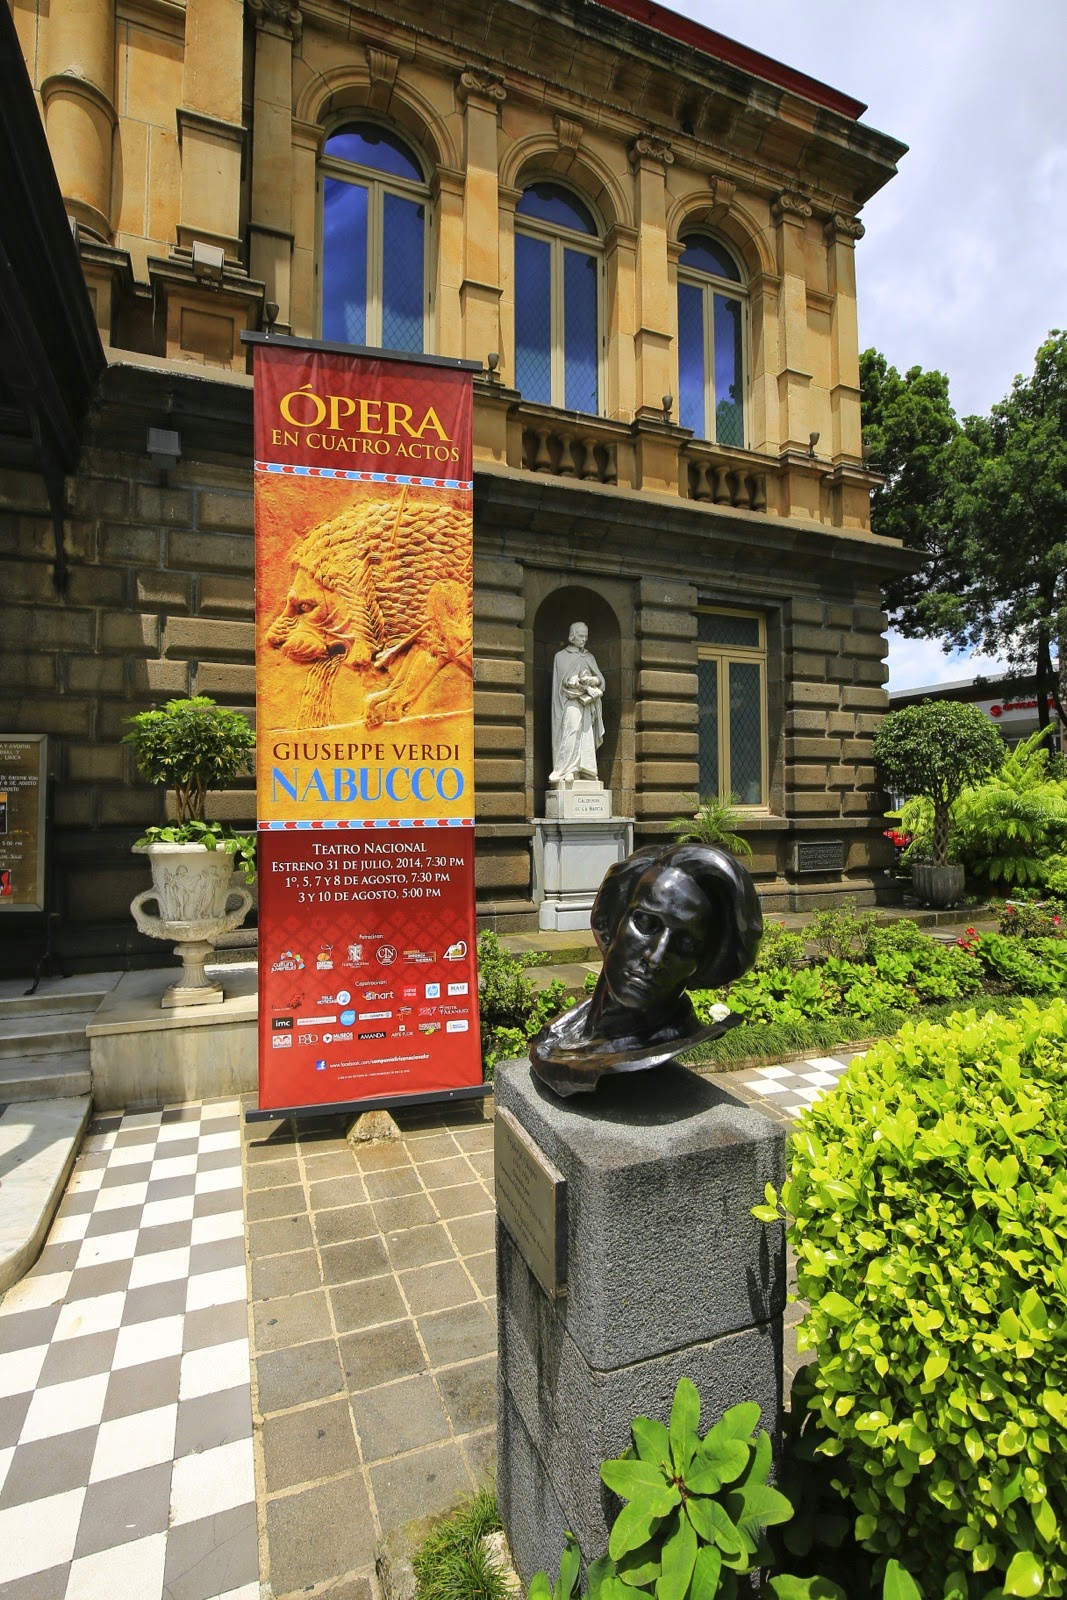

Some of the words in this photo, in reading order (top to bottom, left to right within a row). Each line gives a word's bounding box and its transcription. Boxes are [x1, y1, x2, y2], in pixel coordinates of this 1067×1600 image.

[280, 384, 453, 442] ÓPERA
[272, 430, 299, 447] EN
[306, 433, 390, 455] CUATRO
[394, 442, 460, 462] ACTOS
[272, 742, 385, 761] GIUSEPPE
[391, 744, 460, 761] VERDI
[270, 767, 465, 802] NABUCCO
[272, 861, 323, 872] ESTRENO
[326, 860, 338, 870] 31
[343, 860, 357, 870] DE
[360, 860, 393, 871] JULIO,
[396, 858, 423, 868] 2014,
[426, 857, 447, 867] 7:30
[450, 858, 464, 866] PM
[303, 877, 312, 888] 5,
[315, 876, 322, 886] 7
[324, 877, 332, 886] Y
[334, 876, 340, 886] 8
[344, 876, 358, 886] DE
[361, 874, 408, 885] AGOSTO,
[411, 873, 432, 883] 7:30
[435, 873, 450, 882] PM
[298, 893, 306, 903] 3
[307, 893, 315, 902] Y
[318, 891, 331, 902] 10
[334, 892, 349, 901] DE
[351, 890, 399, 901] AGOSTO,
[402, 888, 423, 898] 5:00
[426, 889, 441, 897] PM
